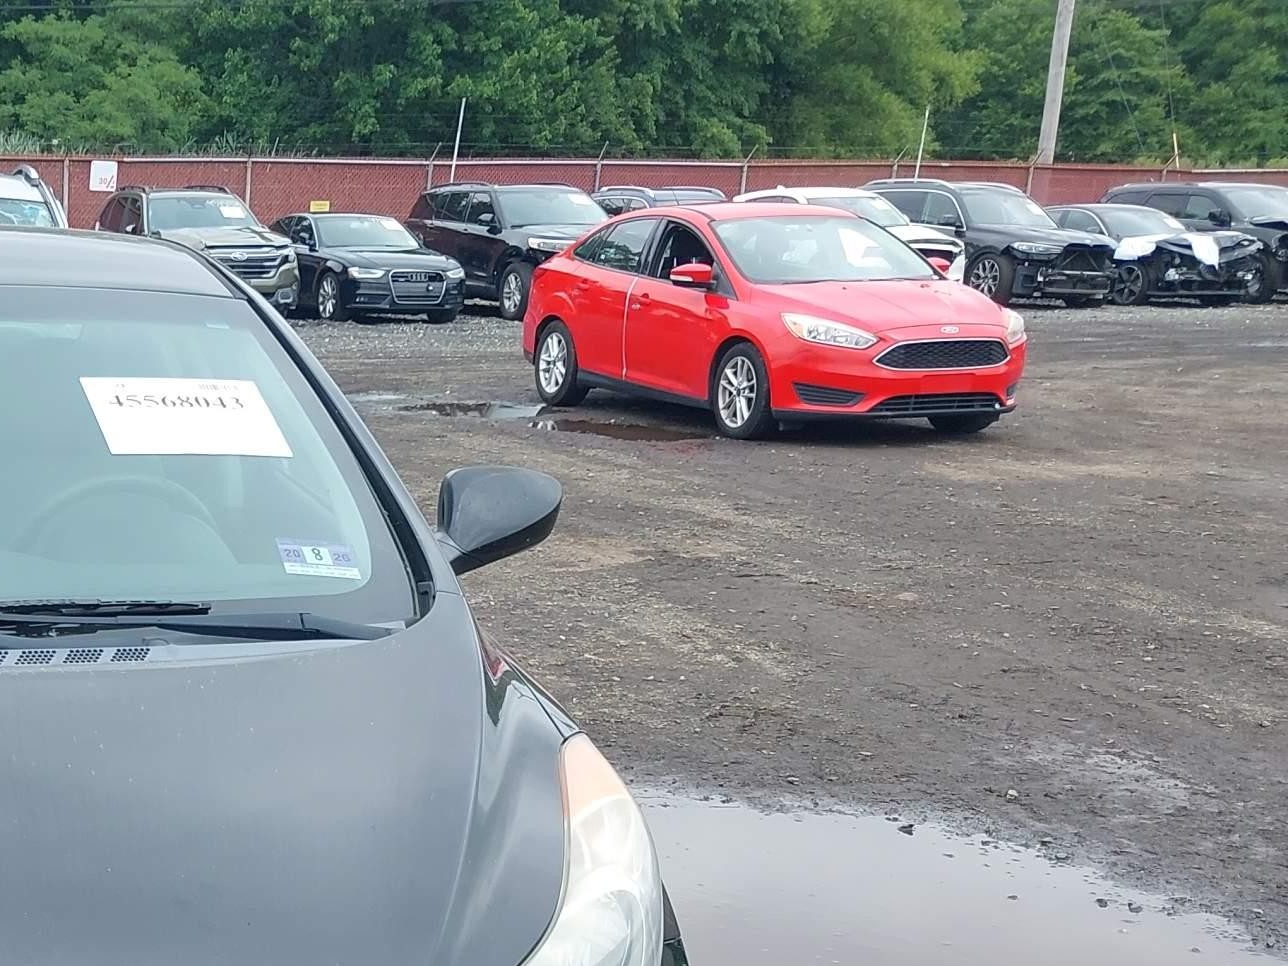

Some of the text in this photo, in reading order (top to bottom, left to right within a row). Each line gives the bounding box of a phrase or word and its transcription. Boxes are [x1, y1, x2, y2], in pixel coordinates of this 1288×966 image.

[109, 394, 244, 409] 45568043
[283, 548, 301, 559] 20
[311, 547, 324, 561] 8
